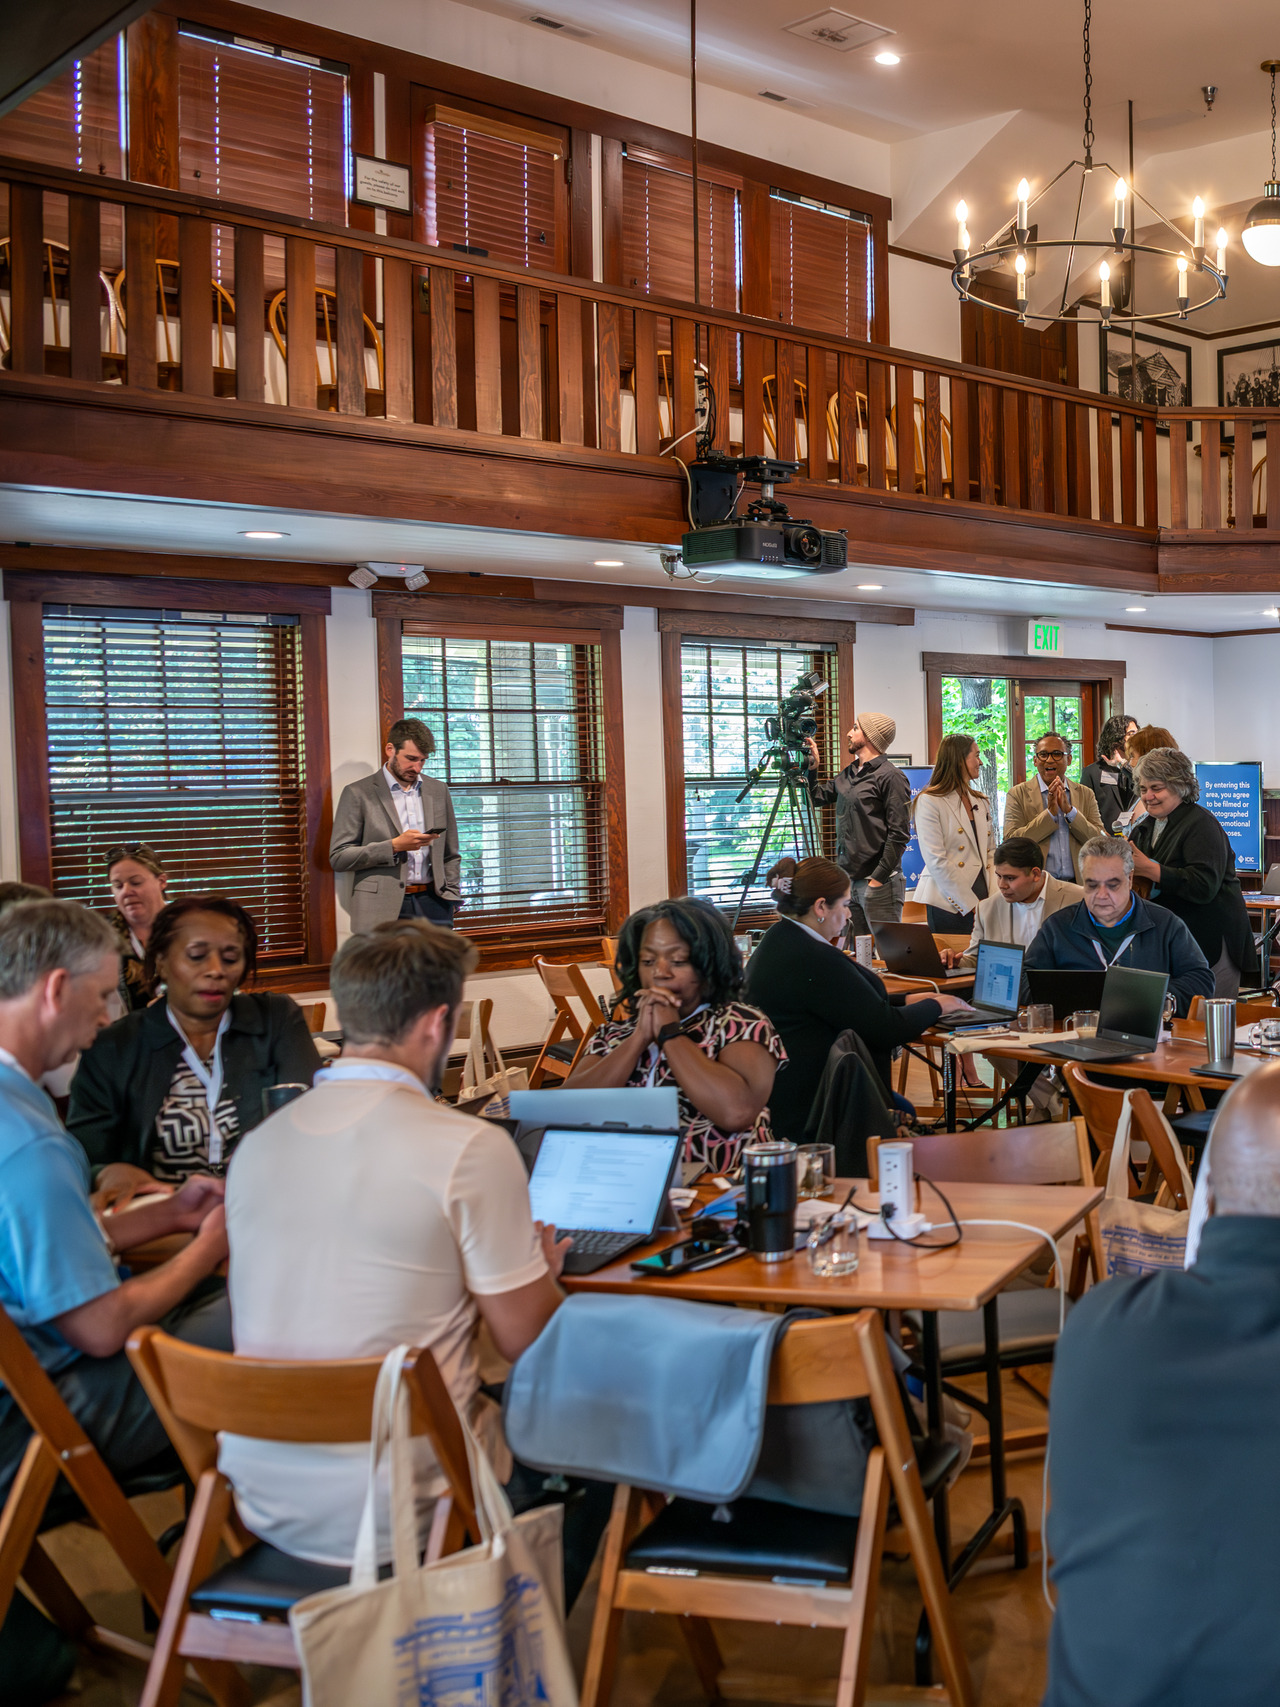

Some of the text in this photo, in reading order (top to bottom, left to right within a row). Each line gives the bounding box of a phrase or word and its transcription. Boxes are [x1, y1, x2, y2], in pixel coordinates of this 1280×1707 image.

[1034, 624, 1060, 651] EXIT
[1205, 782, 1212, 790] By
[1214, 782, 1238, 790] entering
[1211, 810, 1248, 818] hotographed
